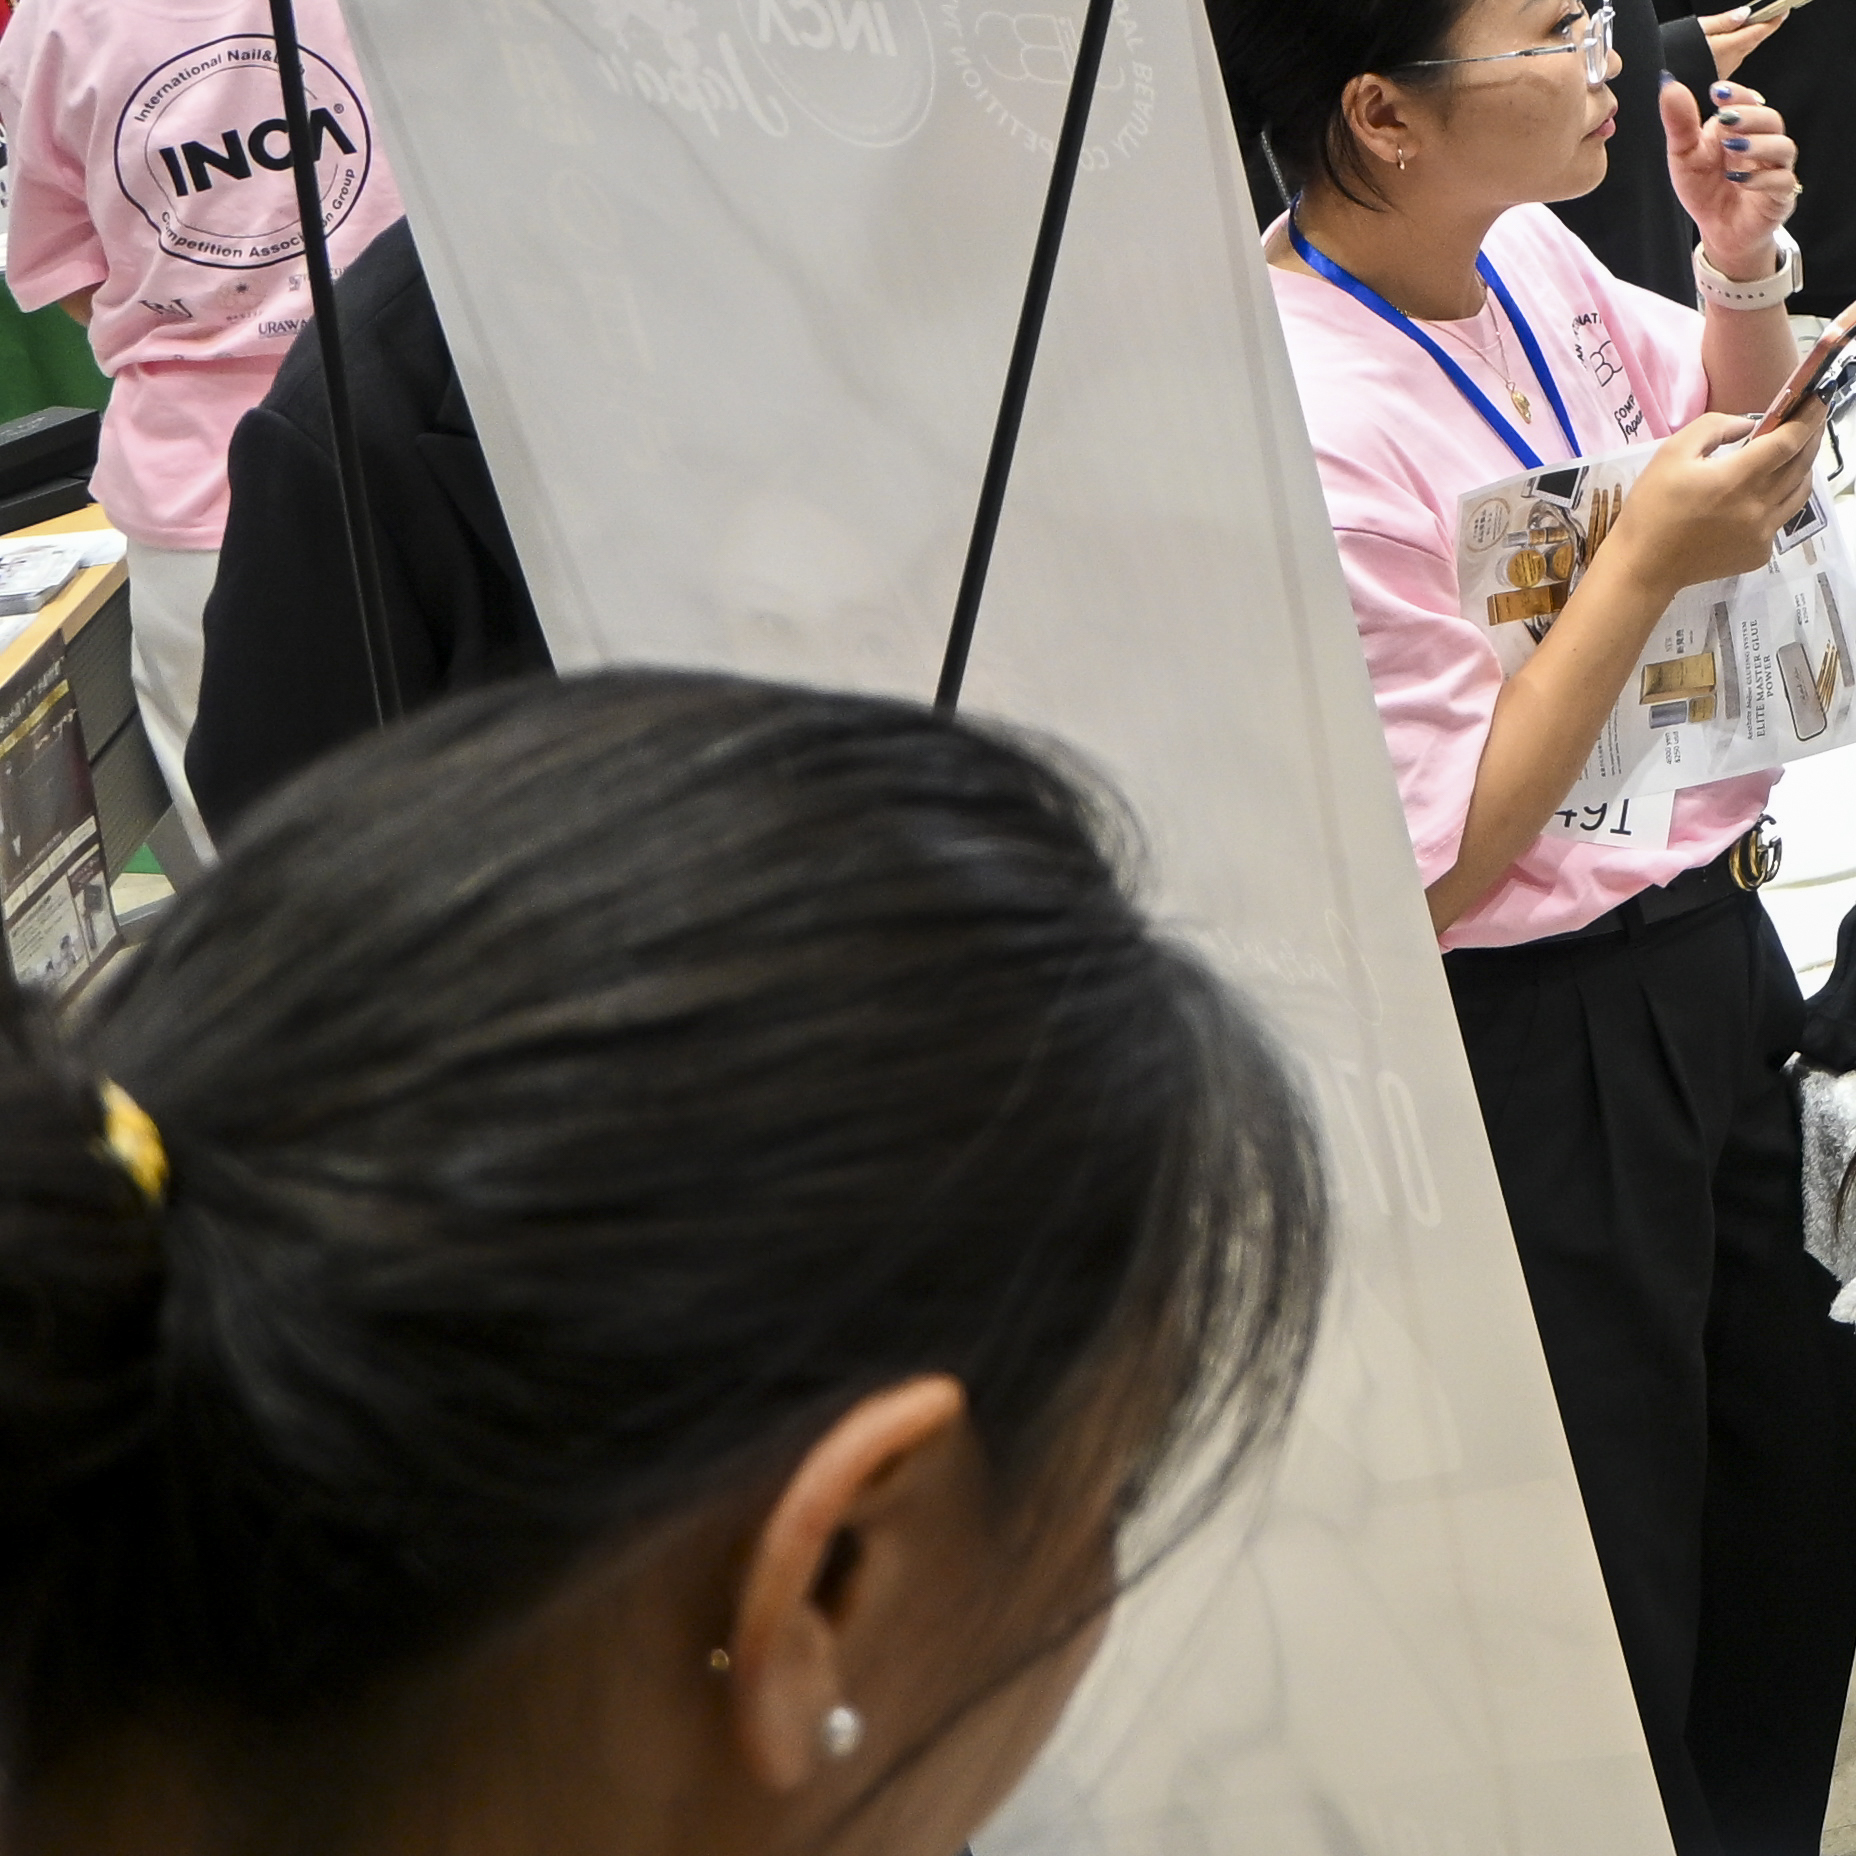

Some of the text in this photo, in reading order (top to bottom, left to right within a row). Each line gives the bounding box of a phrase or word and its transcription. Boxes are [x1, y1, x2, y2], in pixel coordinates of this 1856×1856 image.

[134, 50, 223, 124] International
[332, 167, 357, 211] Group
[1750, 619, 1766, 738] ELITE MASTER GLUE
[1763, 654, 1774, 698] POWER
